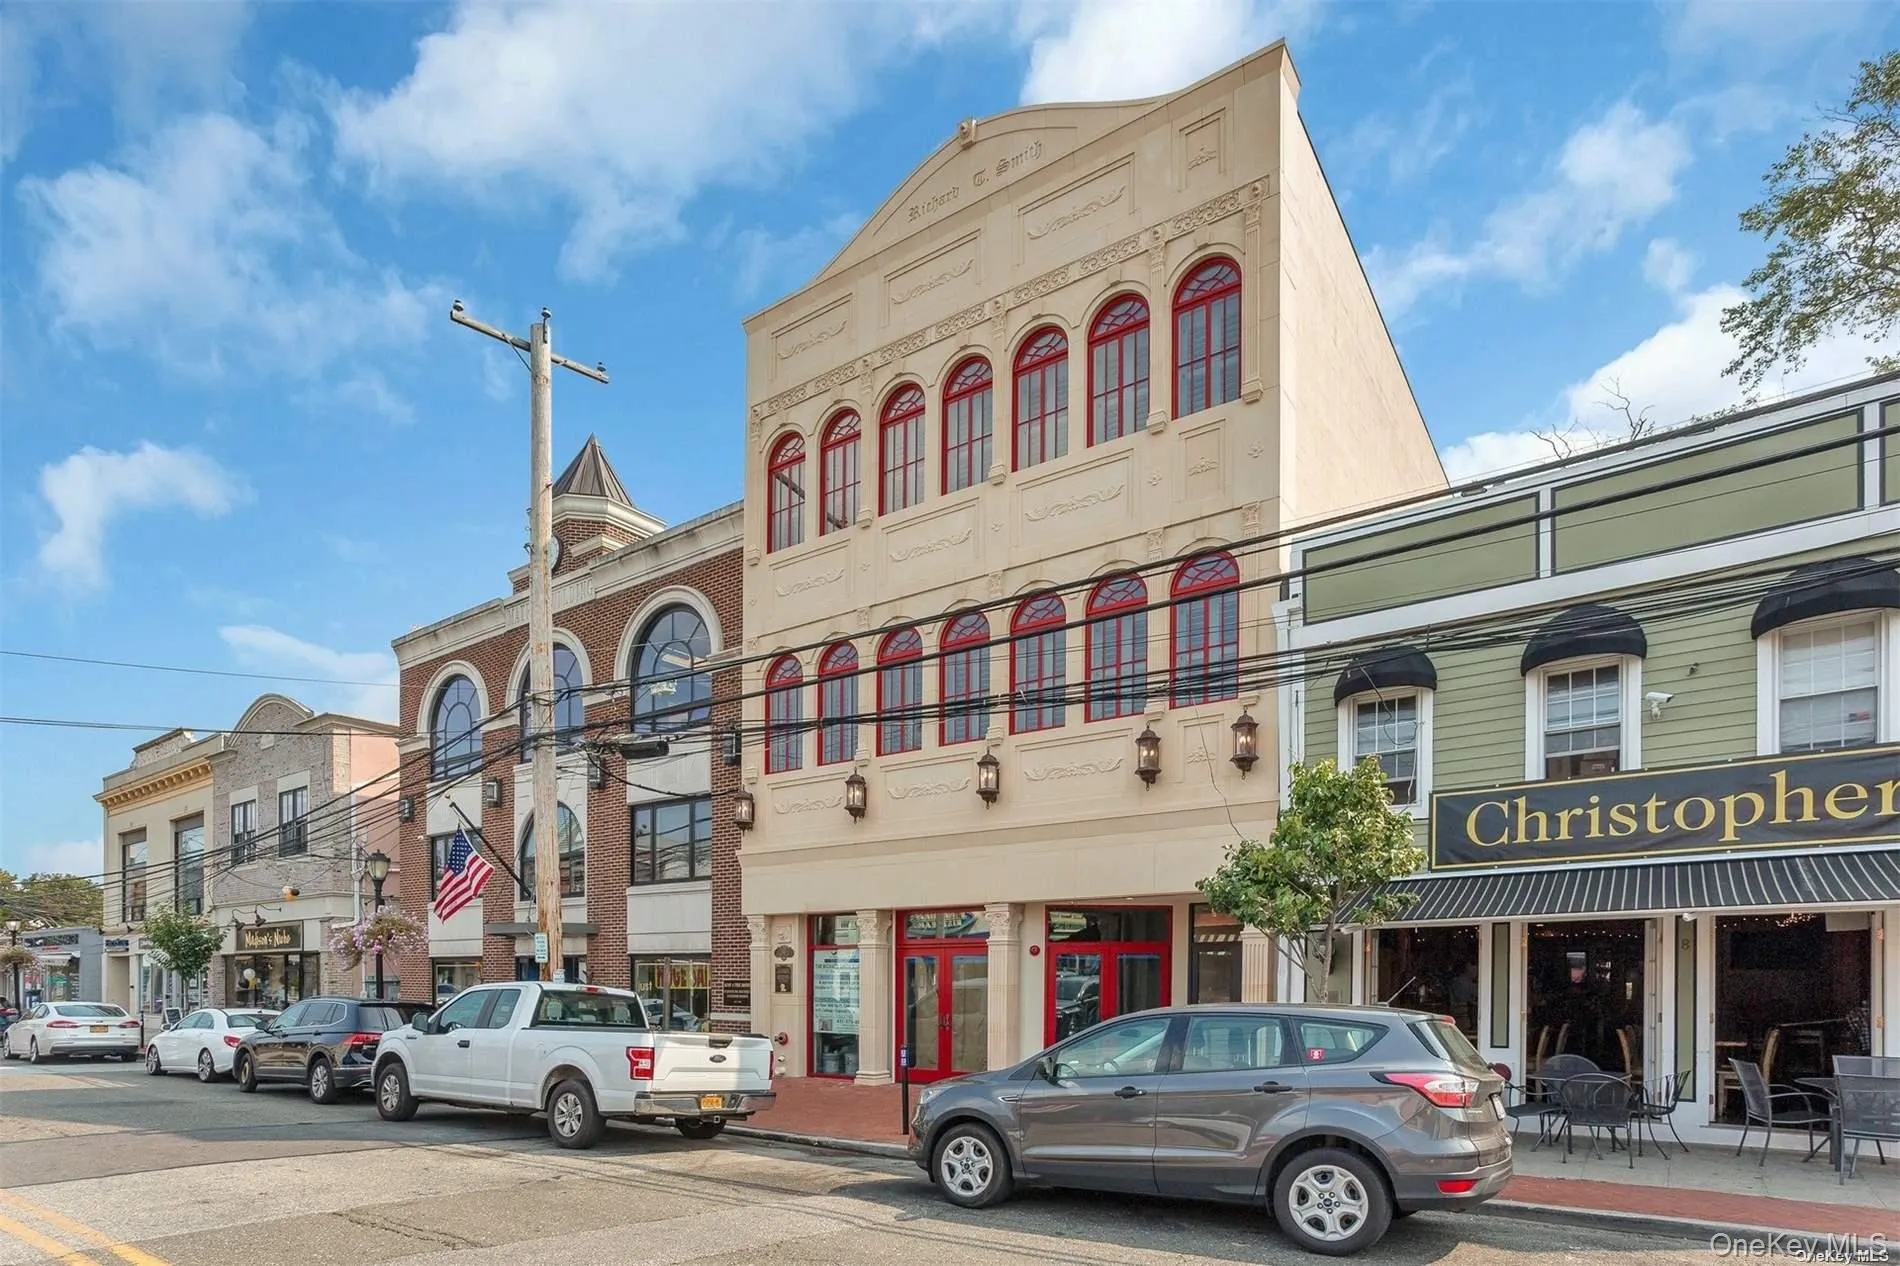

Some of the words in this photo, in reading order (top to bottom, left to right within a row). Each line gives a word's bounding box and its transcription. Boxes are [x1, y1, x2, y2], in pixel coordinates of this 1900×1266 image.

[908, 186, 960, 222] Richard
[995, 139, 1042, 176] Smith
[1681, 938, 1690, 951] 8
